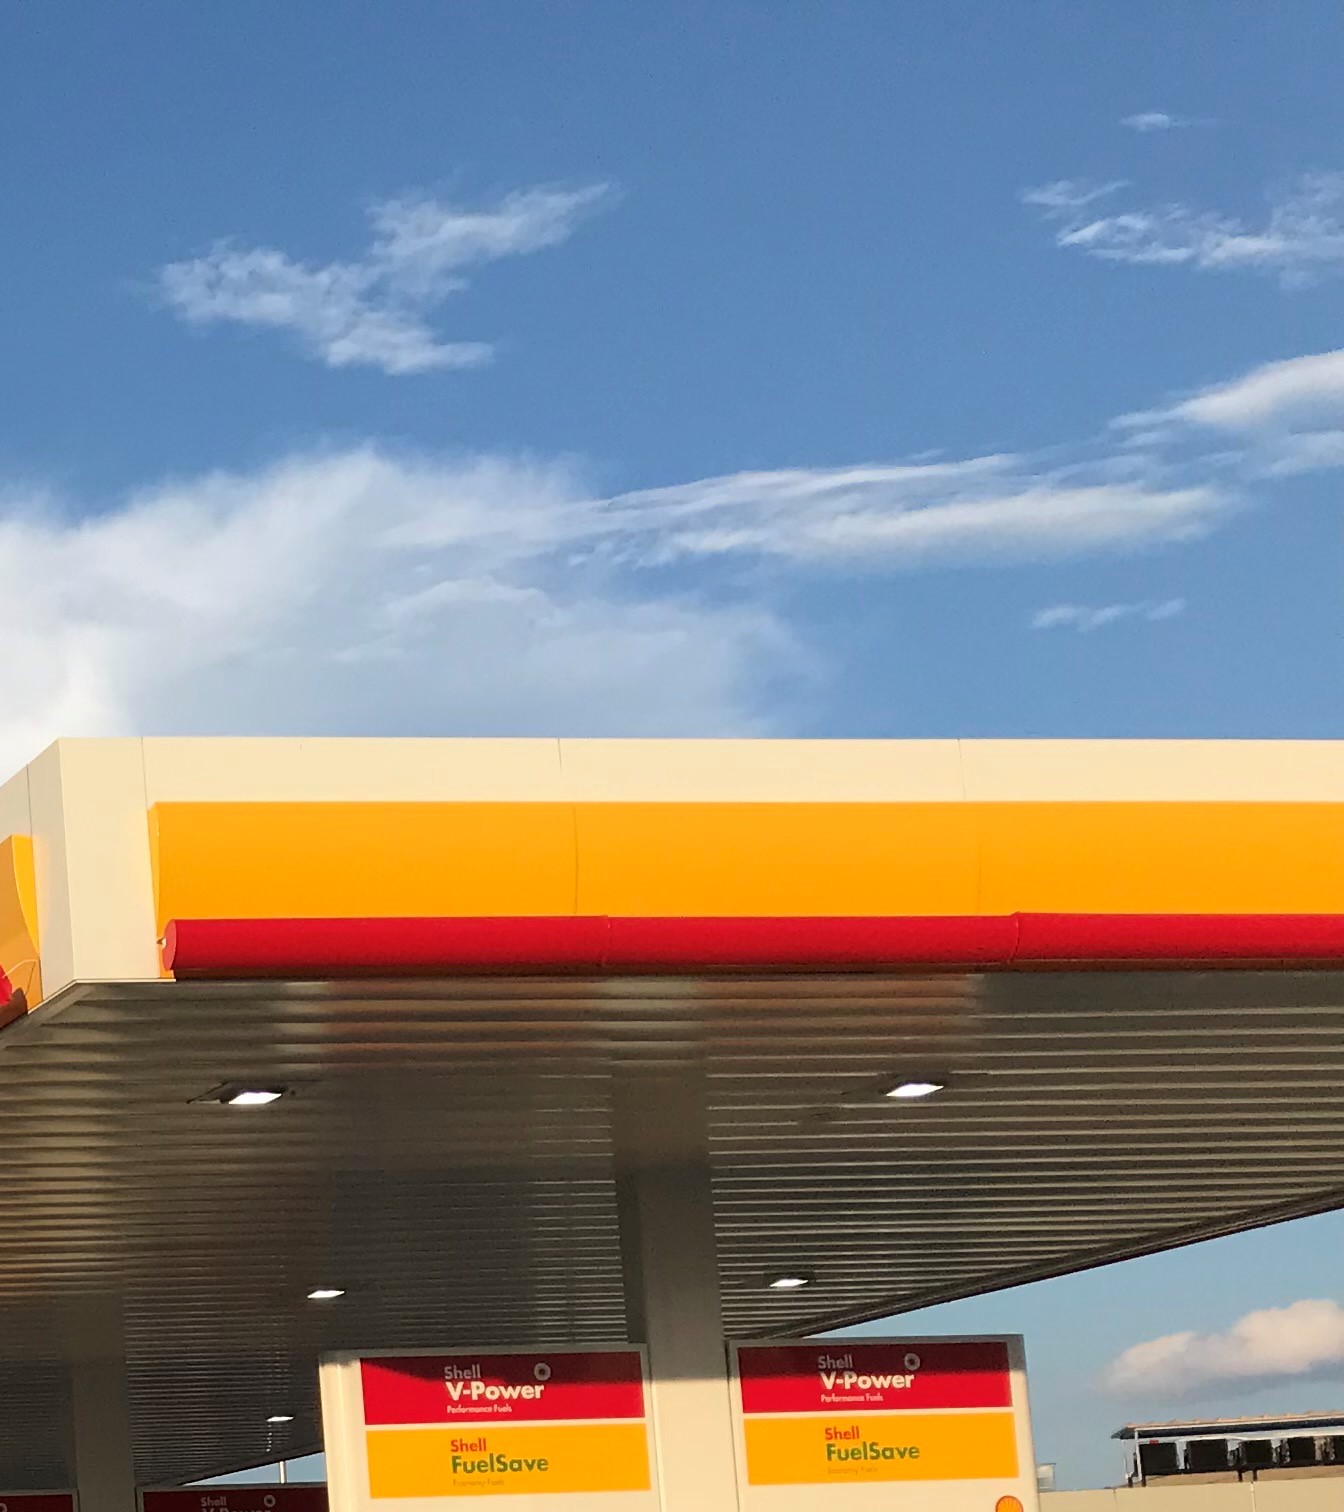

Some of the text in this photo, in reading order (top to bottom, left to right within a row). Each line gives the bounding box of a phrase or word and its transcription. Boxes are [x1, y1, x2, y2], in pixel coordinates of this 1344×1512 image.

[817, 1354, 853, 1369] Shell
[444, 1364, 481, 1380] Shell
[820, 1370, 915, 1390] V-Power
[445, 1380, 545, 1401] V-Power
[825, 1425, 860, 1441] Shell
[450, 1438, 487, 1452] Shell
[826, 1441, 920, 1462] FuelSave
[451, 1453, 549, 1474] FuelSave
[200, 1496, 227, 1507] Shell
